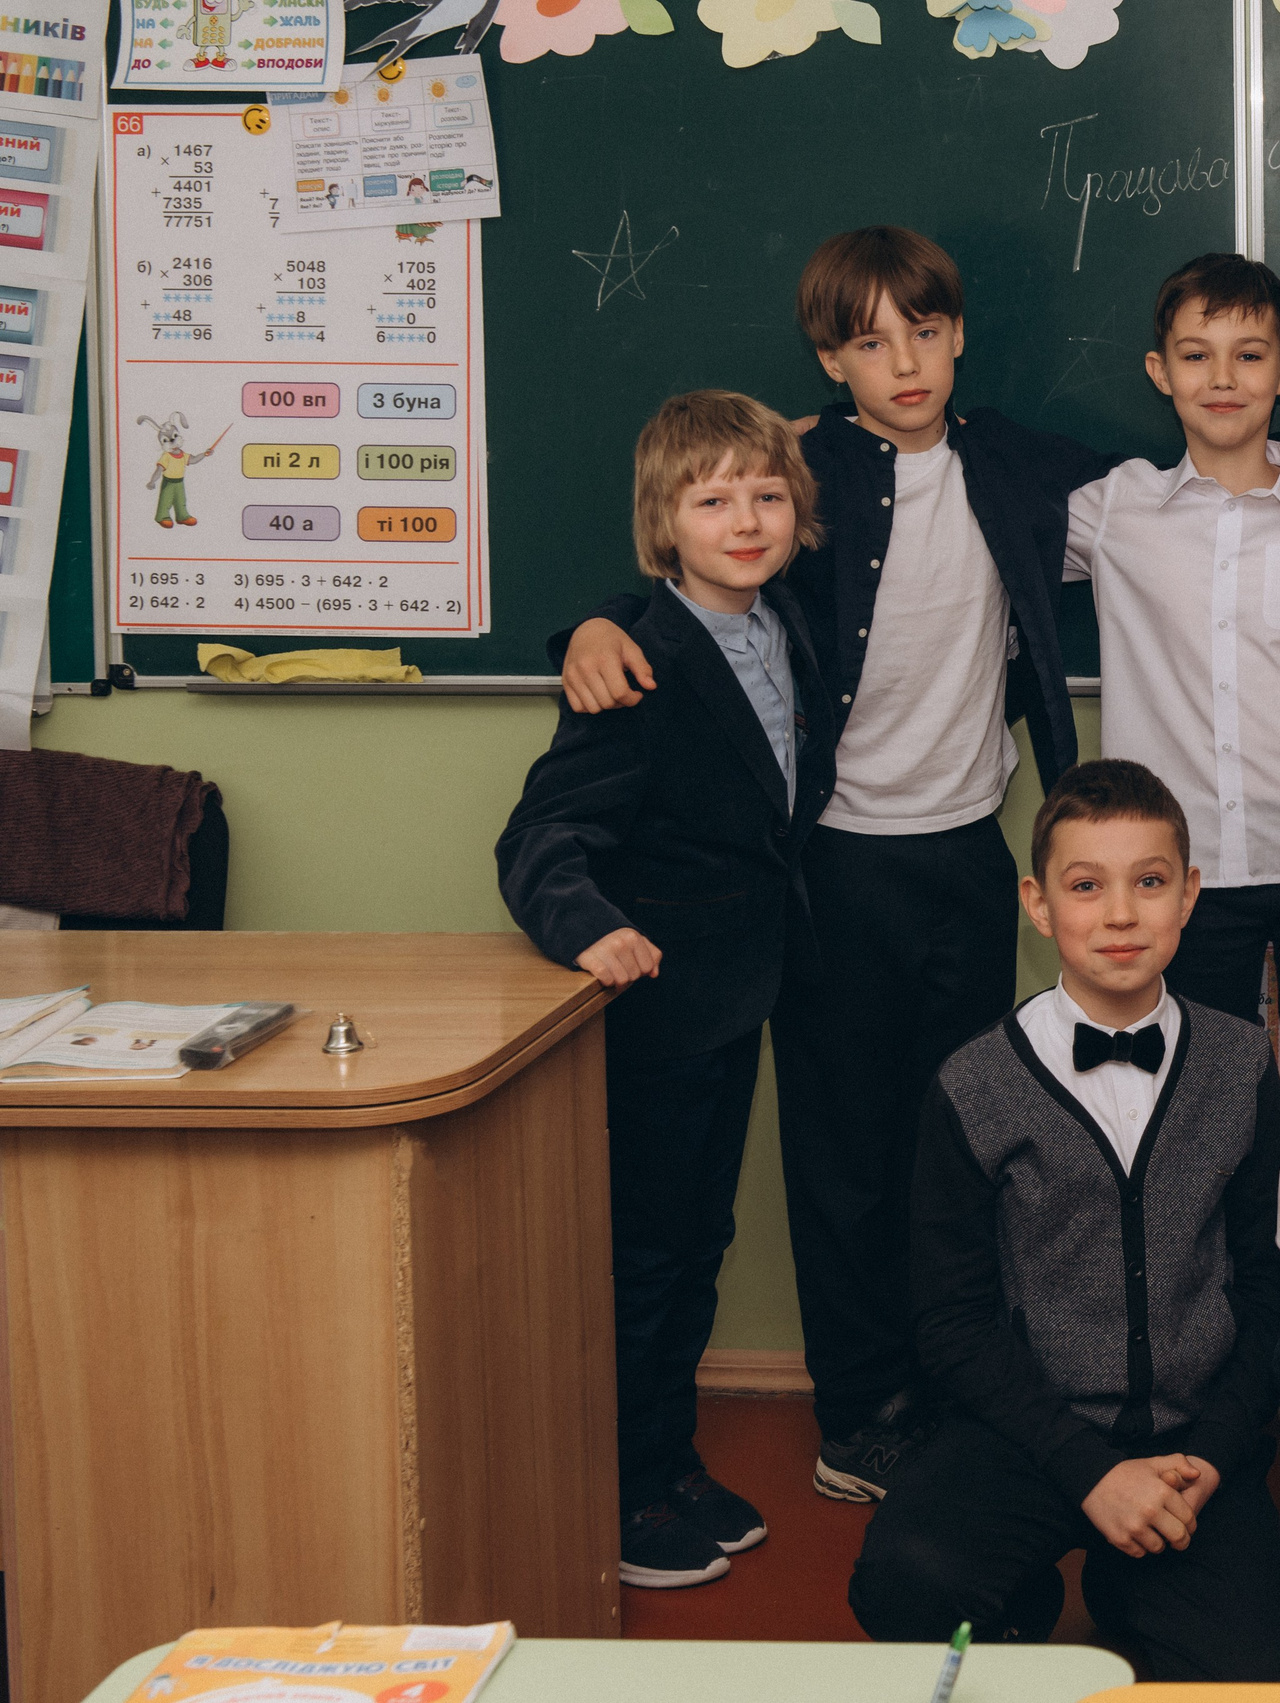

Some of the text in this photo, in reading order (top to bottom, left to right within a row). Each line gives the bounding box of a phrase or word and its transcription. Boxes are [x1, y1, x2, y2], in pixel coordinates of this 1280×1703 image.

[136, 19, 156, 29] НА
[280, 16, 321, 27] ЖАЛЬ
[134, 38, 153, 48] НА
[254, 38, 324, 51] ДОБРАНІЧ
[131, 59, 151, 70] ДО
[256, 58, 323, 69] ВПОДОБИ
[117, 116, 141, 132] 66
[0, 136, 41, 151] ний
[137, 145, 151, 159] а)
[174, 145, 213, 156] 1467
[194, 162, 213, 173] 53
[173, 181, 212, 192] 4401
[163, 197, 202, 209] 7335
[163, 216, 212, 227] 77751
[137, 260, 152, 275] б)
[172, 258, 212, 269] 2416
[286, 260, 326, 272] 5048
[397, 262, 436, 273] 1705
[183, 274, 212, 286] 306
[298, 277, 326, 289] 103
[406, 279, 436, 290] 402
[258, 391, 326, 407] 100 вп
[372, 392, 441, 412] 3 буна
[263, 452, 320, 468] пі 2 л
[365, 454, 450, 473] і 100 рія
[269, 515, 314, 531] 40 а
[376, 517, 437, 533] ті 100
[130, 572, 205, 587] 1) 695 3
[234, 573, 249, 588] 3)
[255, 574, 284, 587] 695
[301, 575, 311, 587] 3
[332, 575, 362, 588] 642
[379, 576, 388, 588] 2
[129, 596, 205, 610] 2) 642 2
[234, 597, 249, 611] 4)
[255, 598, 295, 610] 4500
[316, 598, 351, 613] (695
[368, 600, 378, 611] 3
[400, 600, 429, 612] 642
[446, 600, 462, 615] 2)
